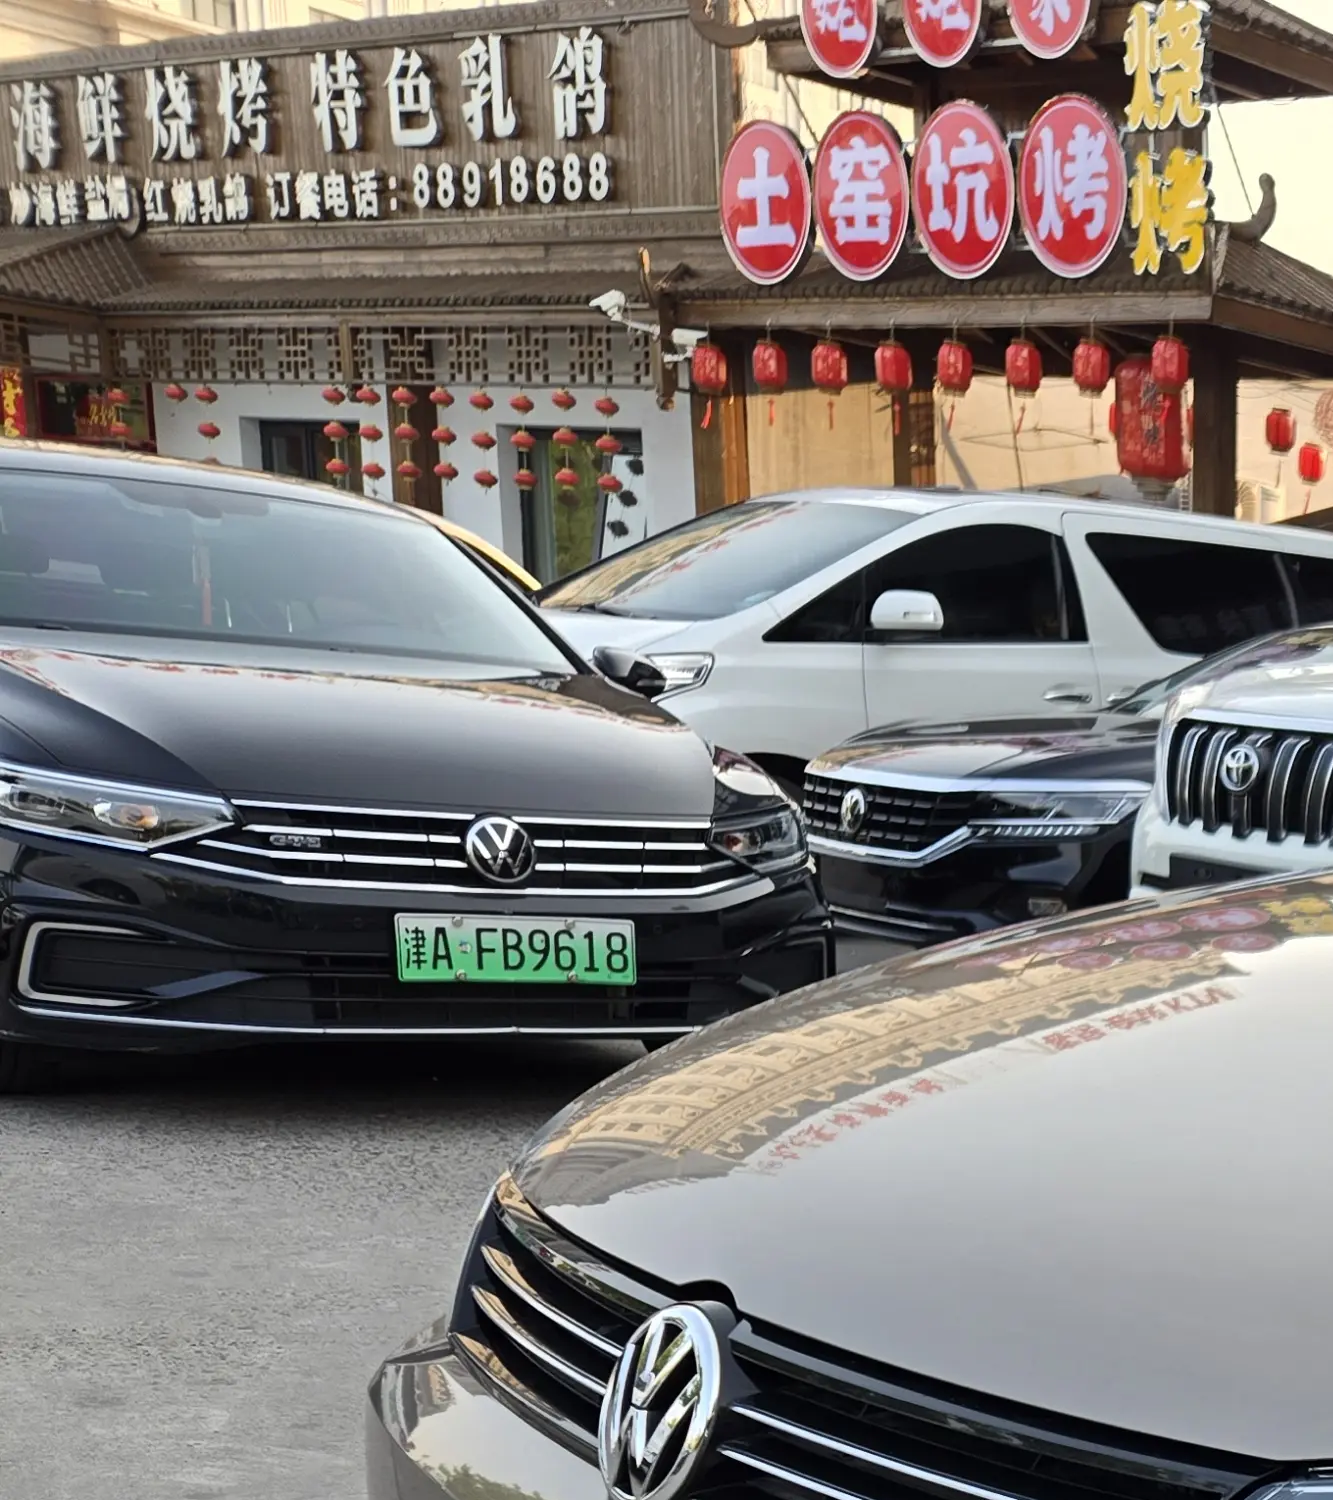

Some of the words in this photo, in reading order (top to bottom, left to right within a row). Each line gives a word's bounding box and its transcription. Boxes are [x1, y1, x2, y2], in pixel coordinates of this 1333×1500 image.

[11, 57, 268, 172] 海鲜烧烤
[311, 26, 607, 153] 特色乳鸽
[1123, 0, 1208, 275] 烧烤
[735, 123, 1110, 248] 土窑坑烤
[404, 926, 454, 971] 津A
[475, 927, 629, 973] FB9618
